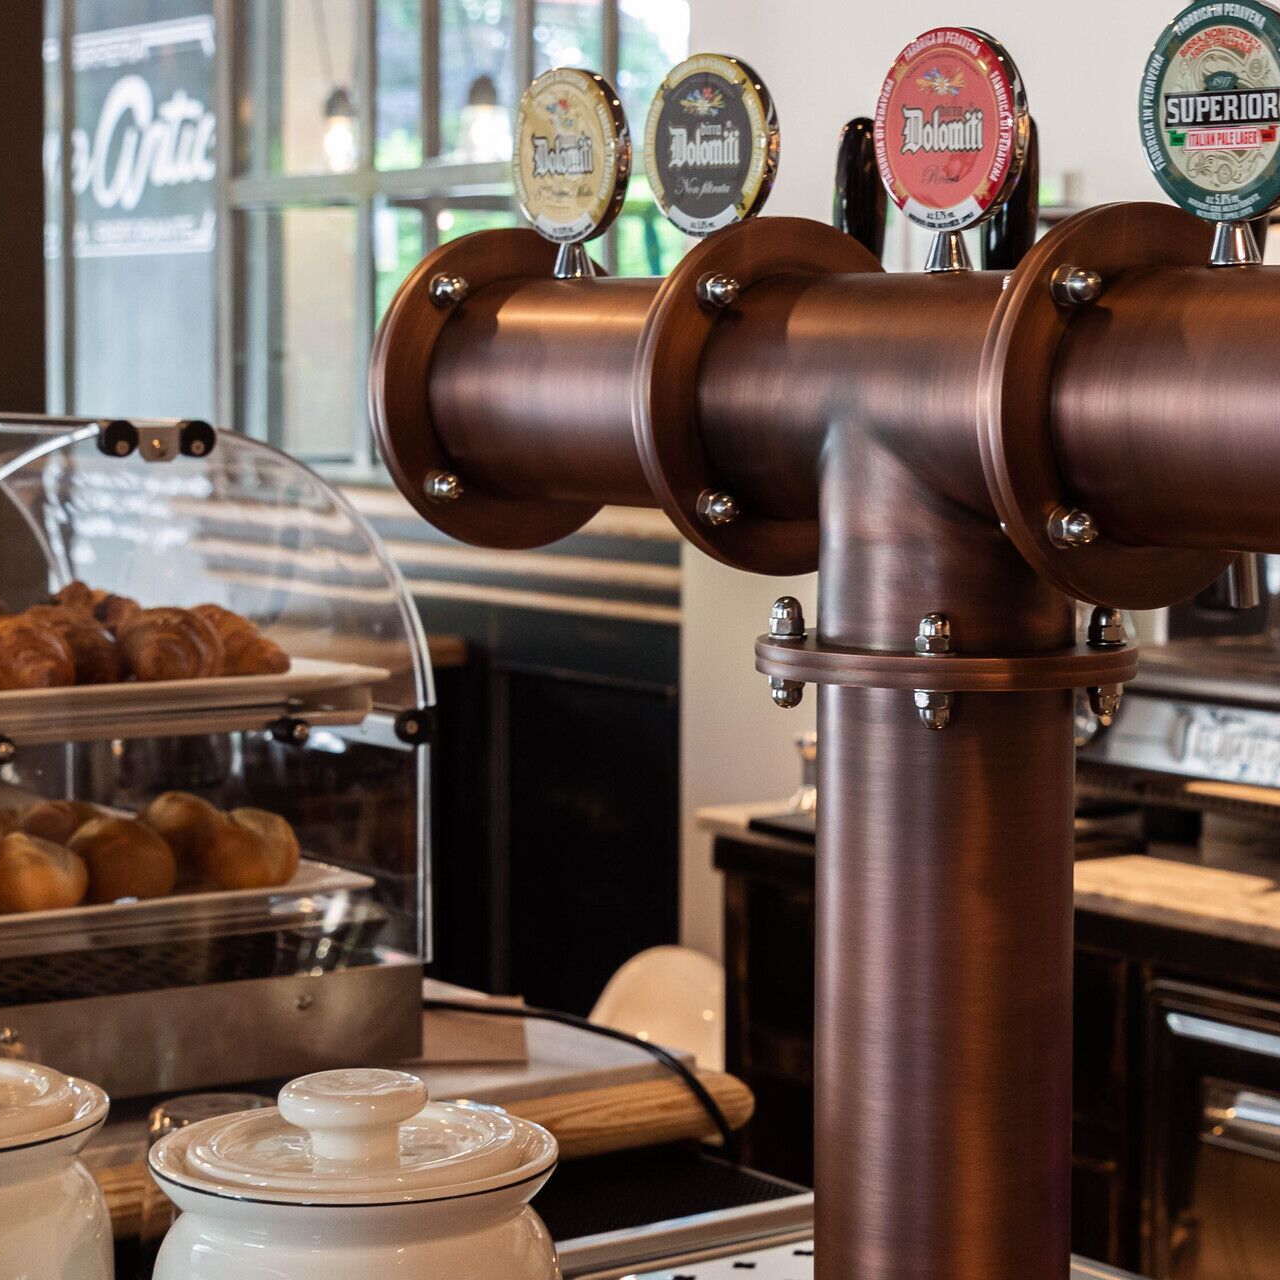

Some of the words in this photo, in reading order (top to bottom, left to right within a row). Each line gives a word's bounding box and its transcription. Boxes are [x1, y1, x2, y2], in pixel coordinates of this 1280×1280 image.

[1224, 3, 1267, 29] PEDAVENA
[876, 78, 895, 126] PEDAVENA
[1143, 53, 1165, 107] PEDAVENA
[900, 105, 984, 155] Dolomiti
[1142, 109, 1154, 121] IN
[1166, 92, 1280, 124] SUPERIOR
[668, 127, 740, 168] Dolomiti
[989, 131, 1013, 182] PEDAVENA
[1142, 121, 1167, 171] FABBRICA
[1189, 132, 1215, 147] ITALIAN
[1217, 132, 1234, 146] PALE
[1236, 131, 1257, 145] LAGER
